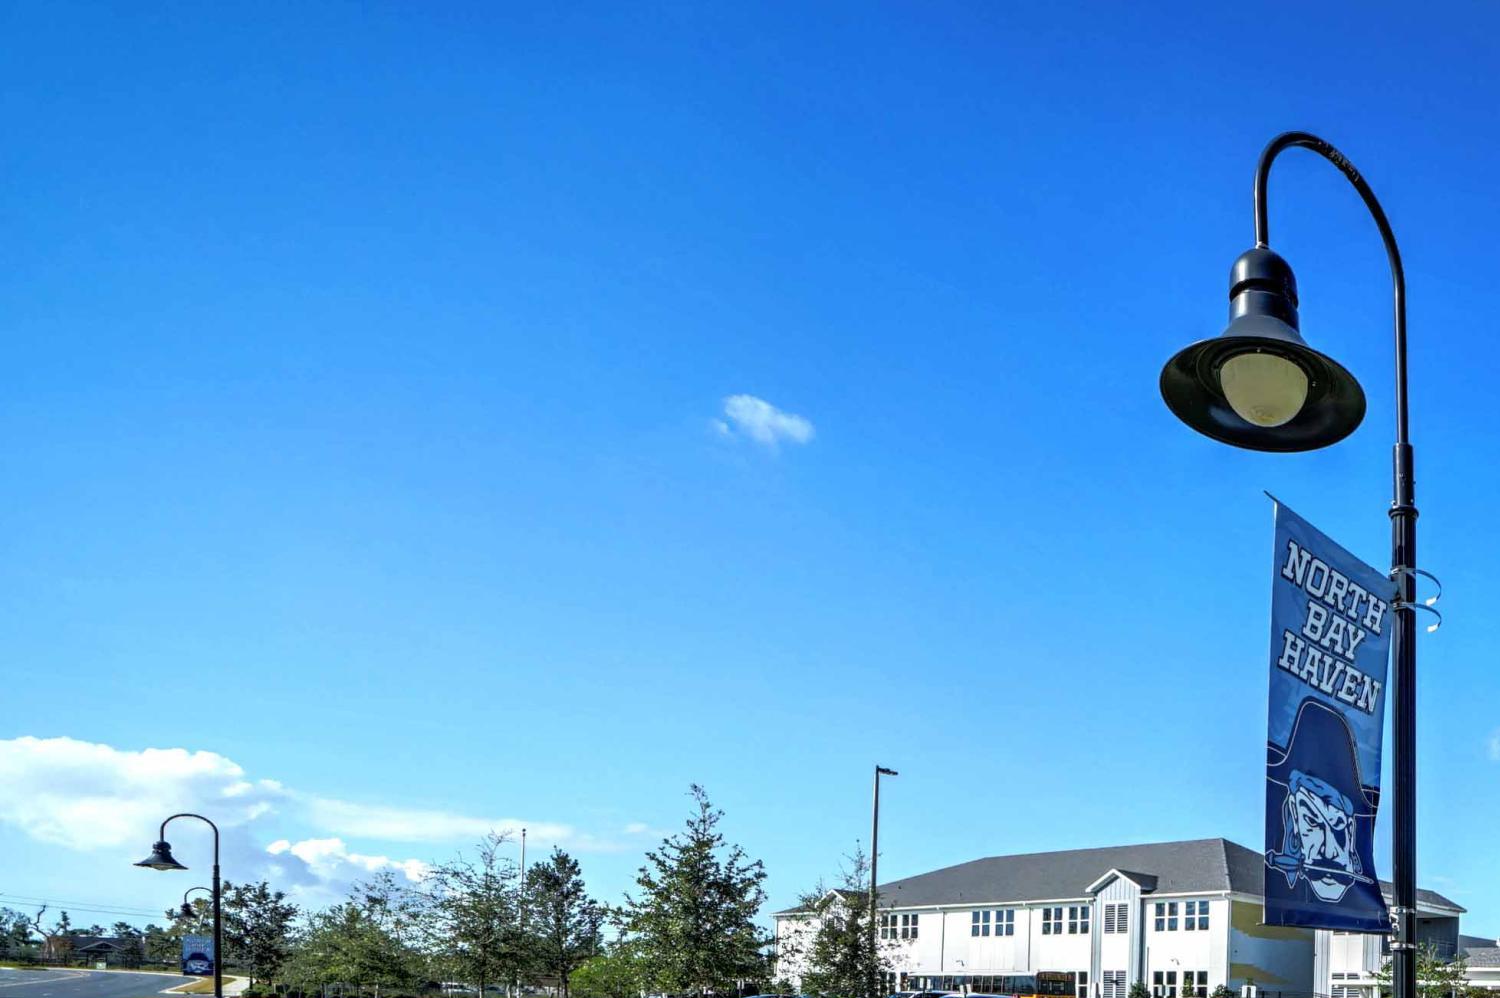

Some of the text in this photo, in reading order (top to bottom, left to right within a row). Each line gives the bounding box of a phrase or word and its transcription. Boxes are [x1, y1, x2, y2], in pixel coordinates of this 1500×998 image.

[1282, 540, 1387, 635] NORTH
[1278, 630, 1382, 713] HAVEN
[1302, 600, 1365, 661] BAY
